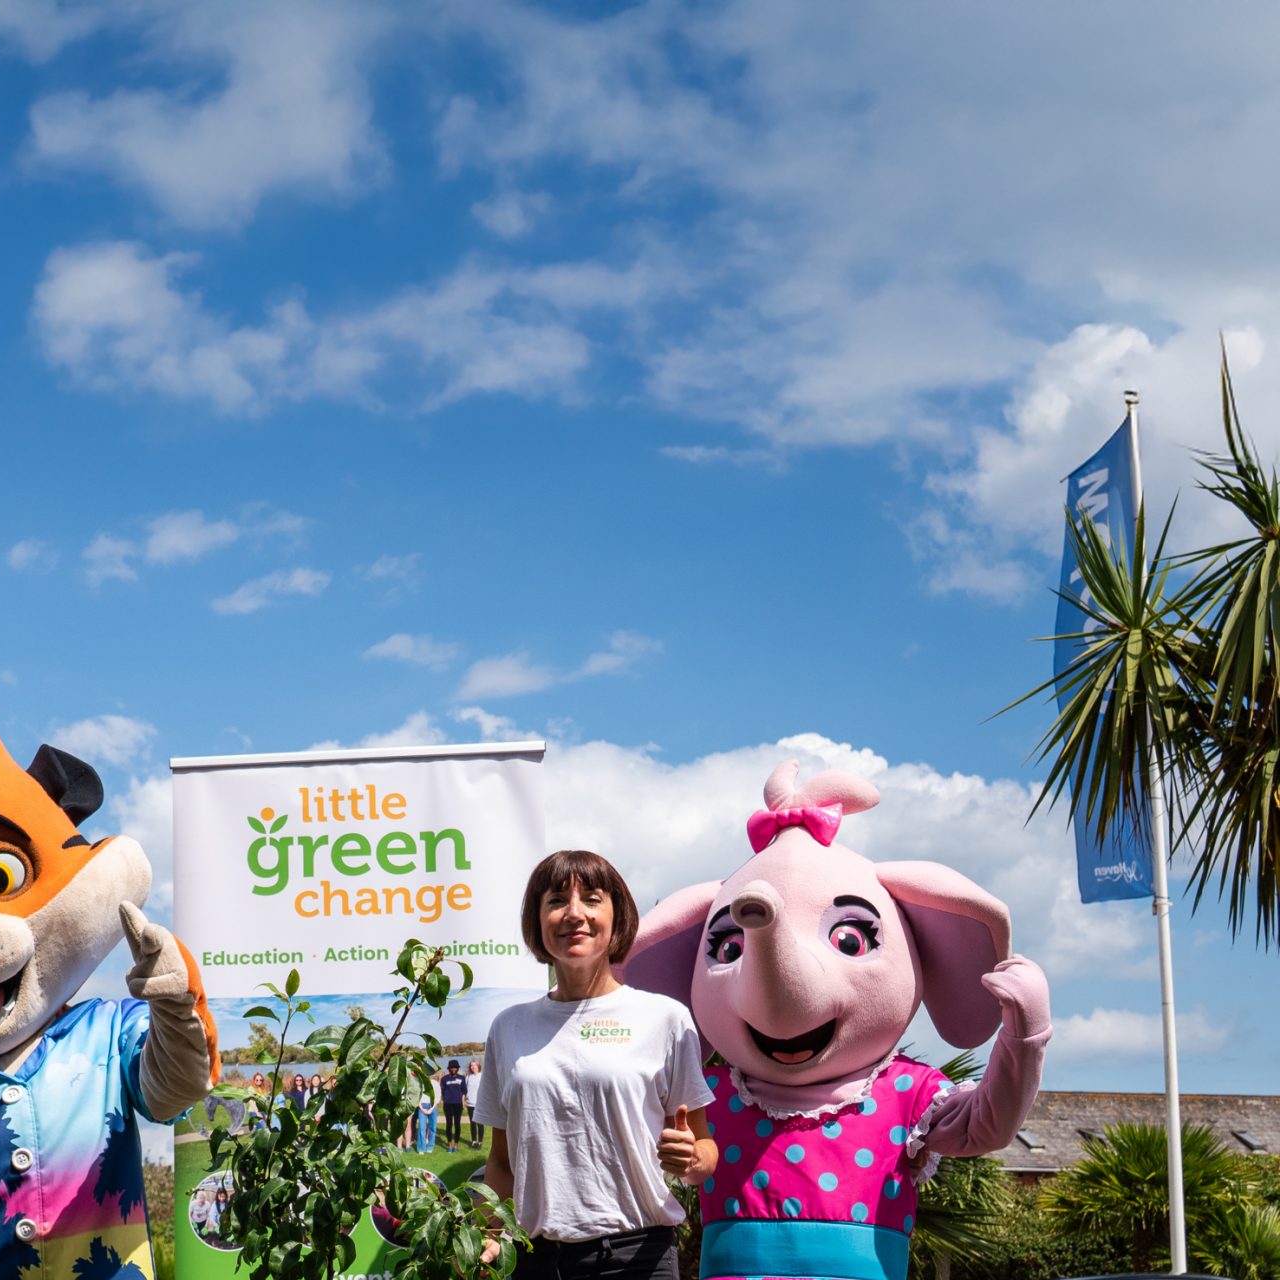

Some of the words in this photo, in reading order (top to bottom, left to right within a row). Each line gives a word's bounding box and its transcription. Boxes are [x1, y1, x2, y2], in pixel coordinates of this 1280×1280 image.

[299, 784, 407, 823] little
[247, 826, 471, 896] green
[294, 880, 472, 923] change
[203, 948, 303, 966] Education
[324, 945, 389, 962] Action
[413, 939, 519, 957] piration
[580, 1025, 631, 1040] green
